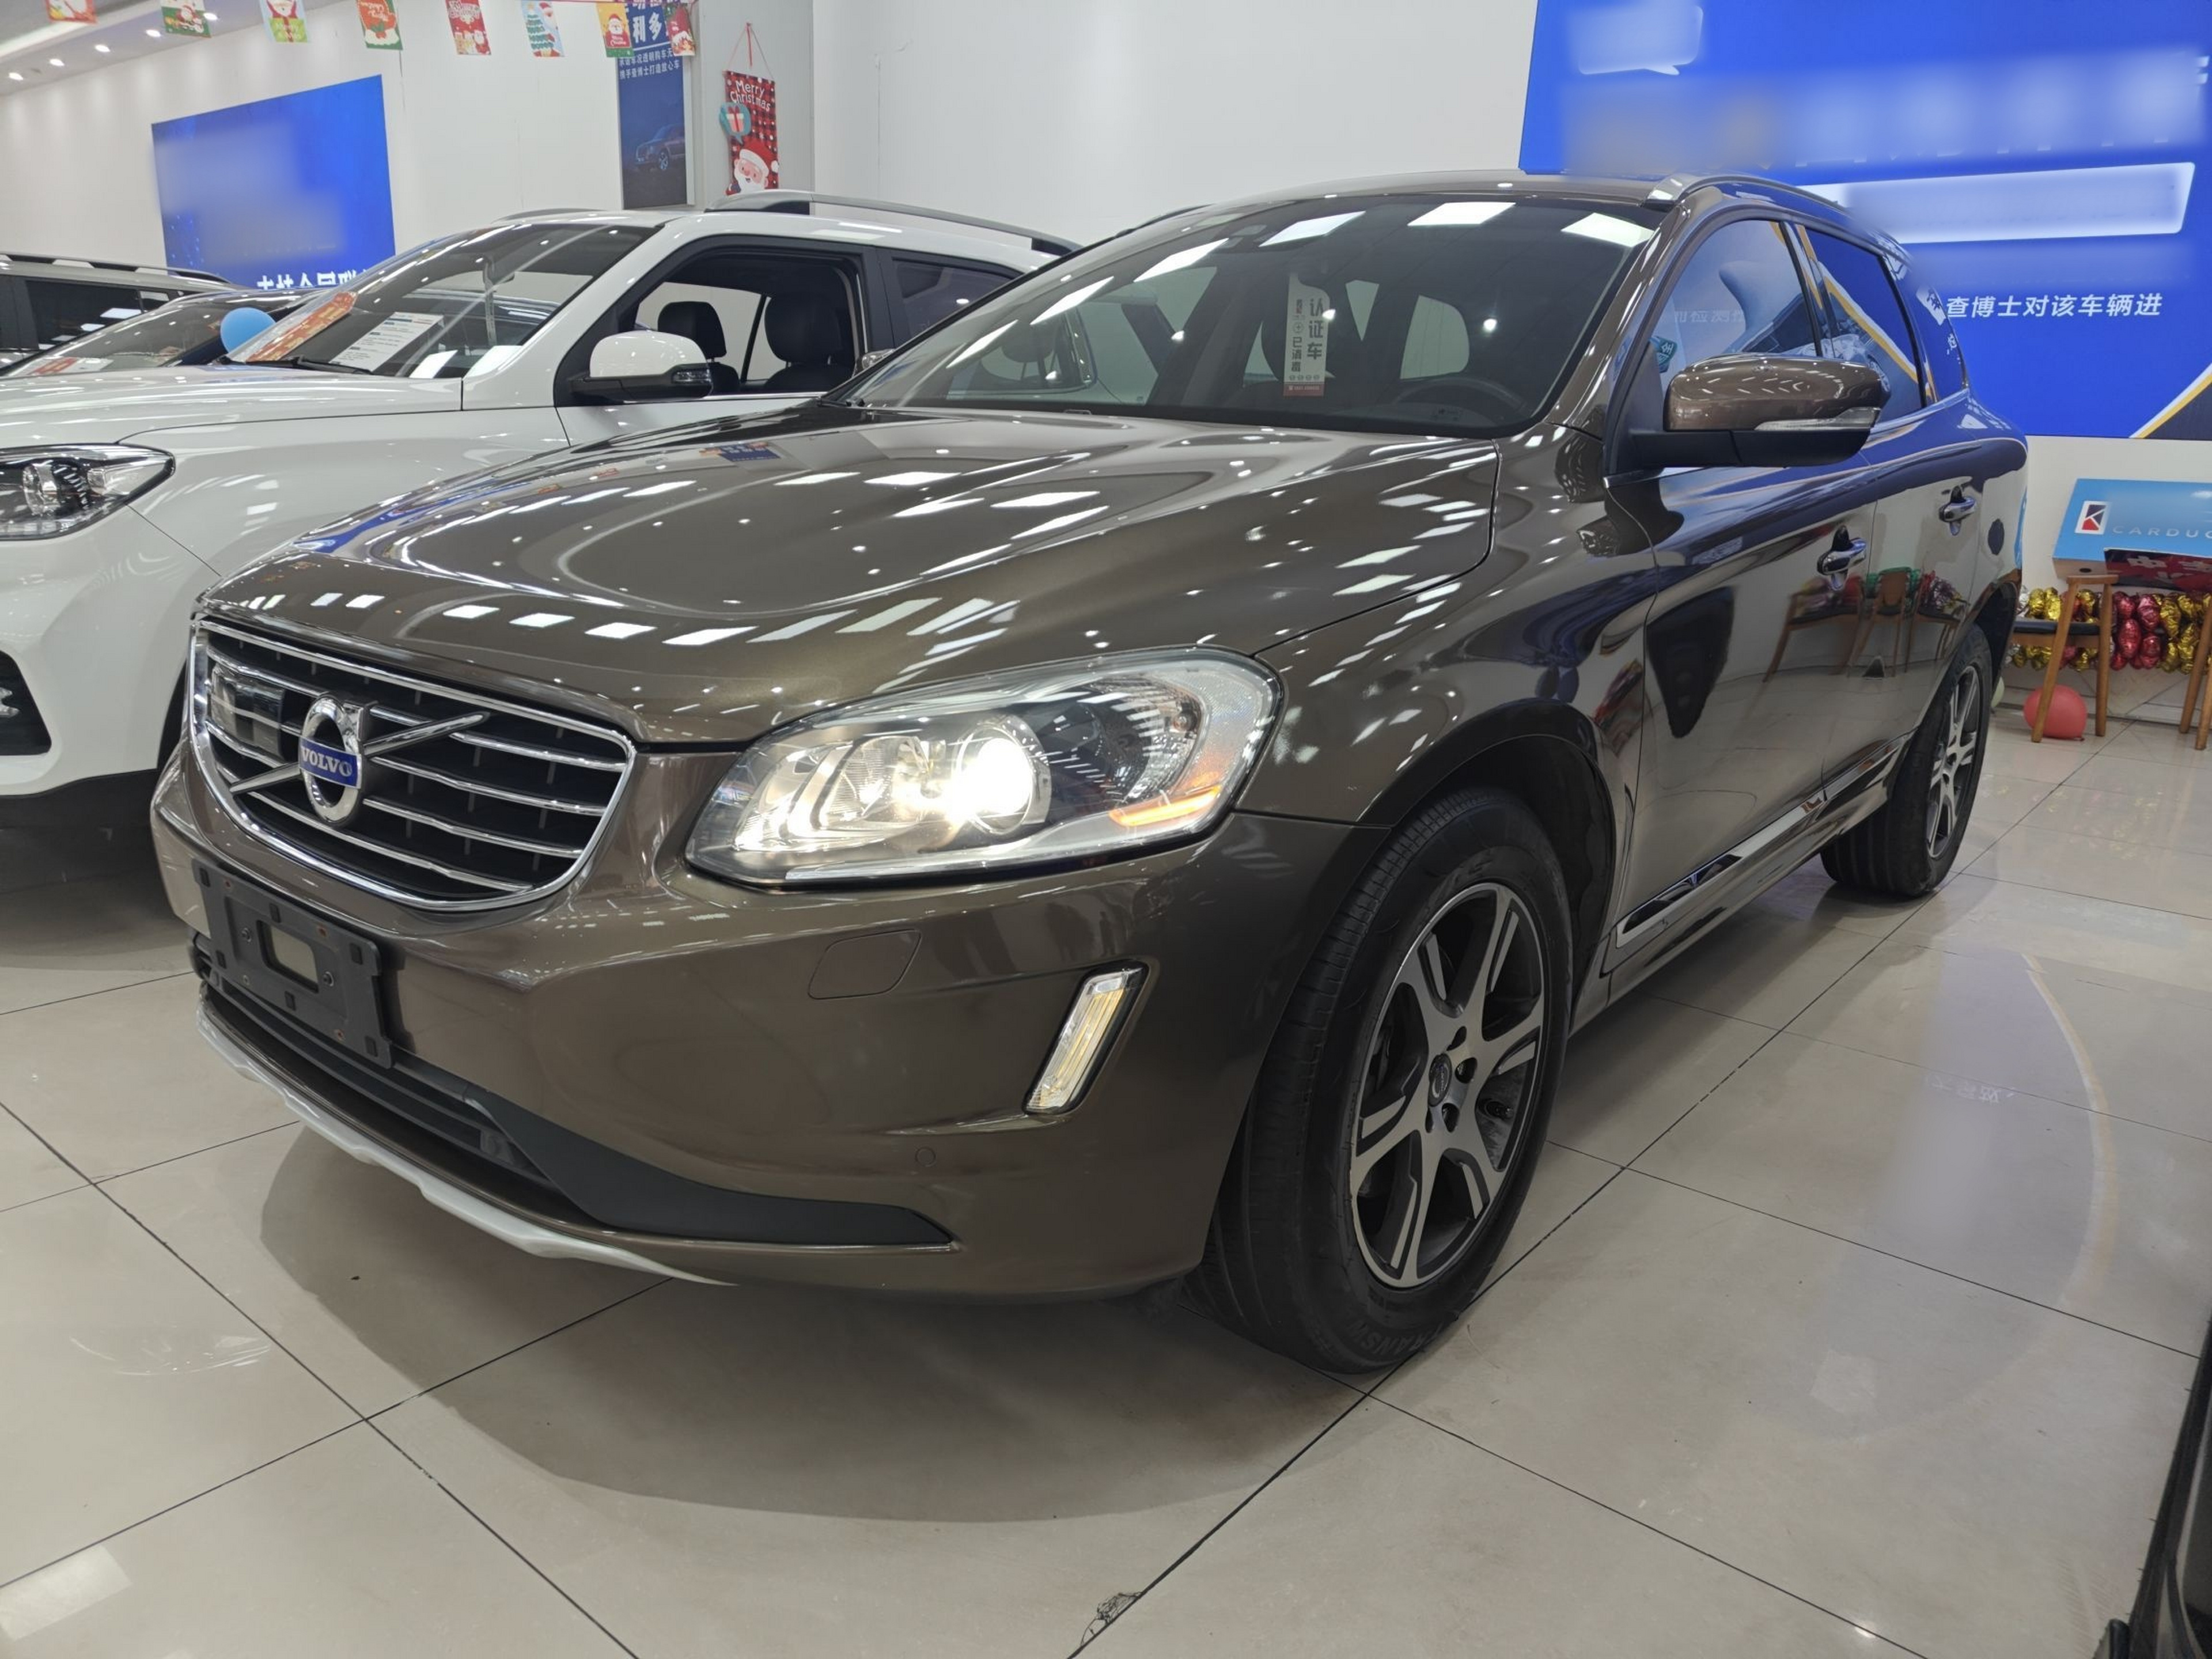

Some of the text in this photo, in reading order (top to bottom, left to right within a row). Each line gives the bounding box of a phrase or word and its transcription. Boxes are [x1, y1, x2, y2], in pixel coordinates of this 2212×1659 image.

[730, 90, 771, 112] Christmas
[736, 80, 765, 98] Merry
[1946, 293, 2163, 318] 查博士对该车辆进
[1306, 298, 1324, 360] 认证车
[301, 745, 353, 777] VOLVO
